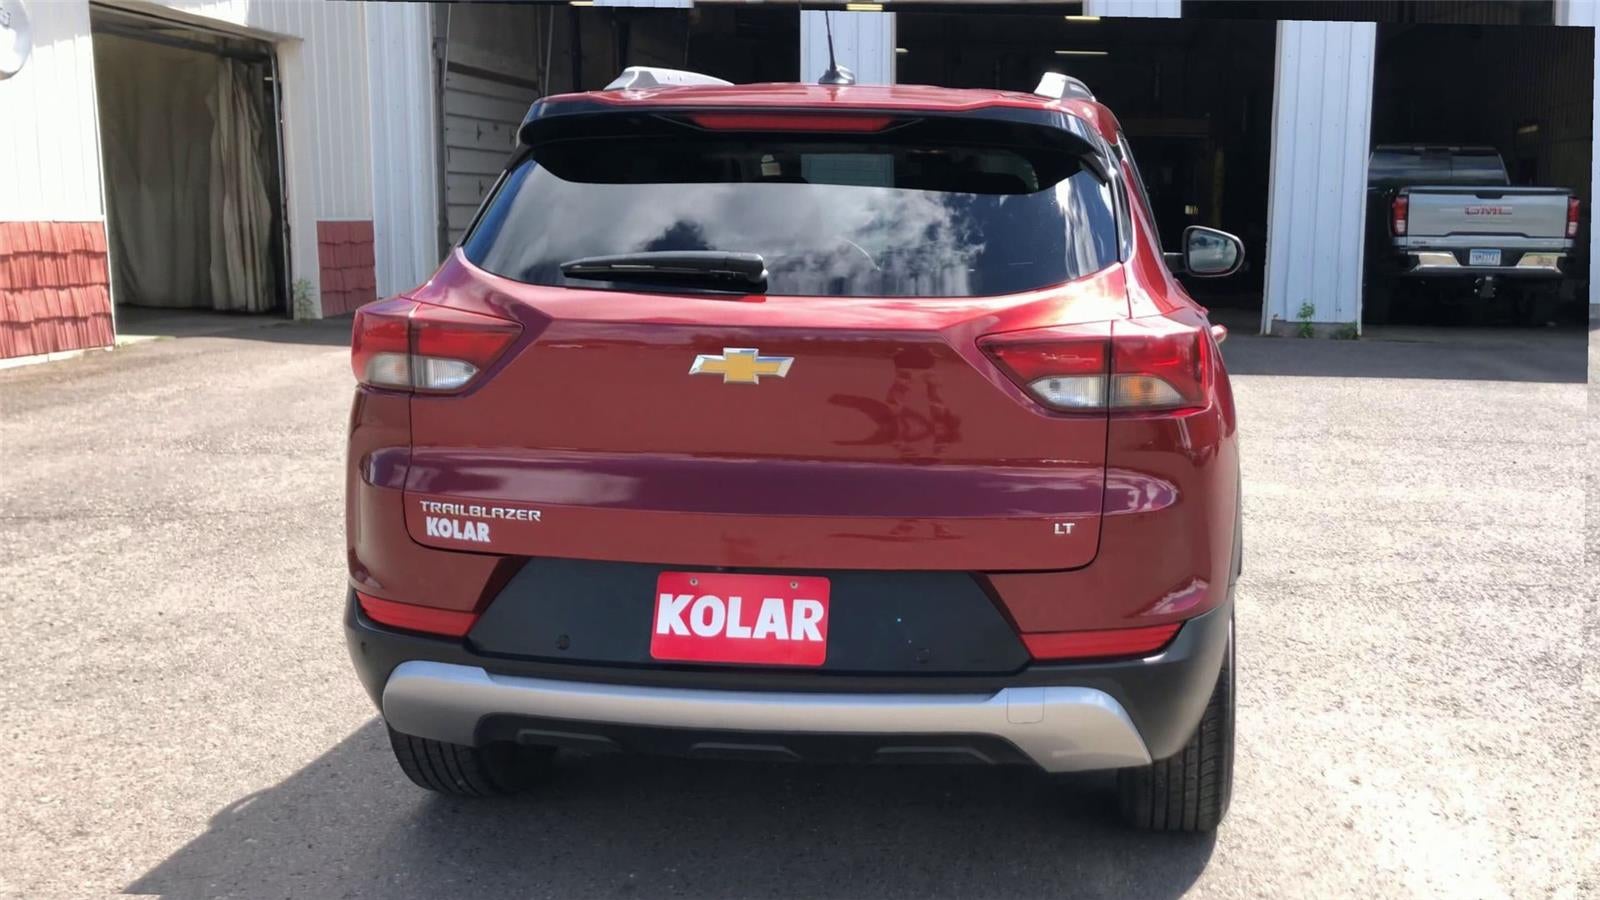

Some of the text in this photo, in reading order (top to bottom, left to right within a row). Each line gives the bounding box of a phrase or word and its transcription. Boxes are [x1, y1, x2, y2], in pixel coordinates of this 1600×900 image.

[420, 500, 542, 521] TRAILBLAZER
[426, 516, 491, 542] KOLAR
[1054, 522, 1076, 535] LT
[656, 593, 825, 642] KOLAR
